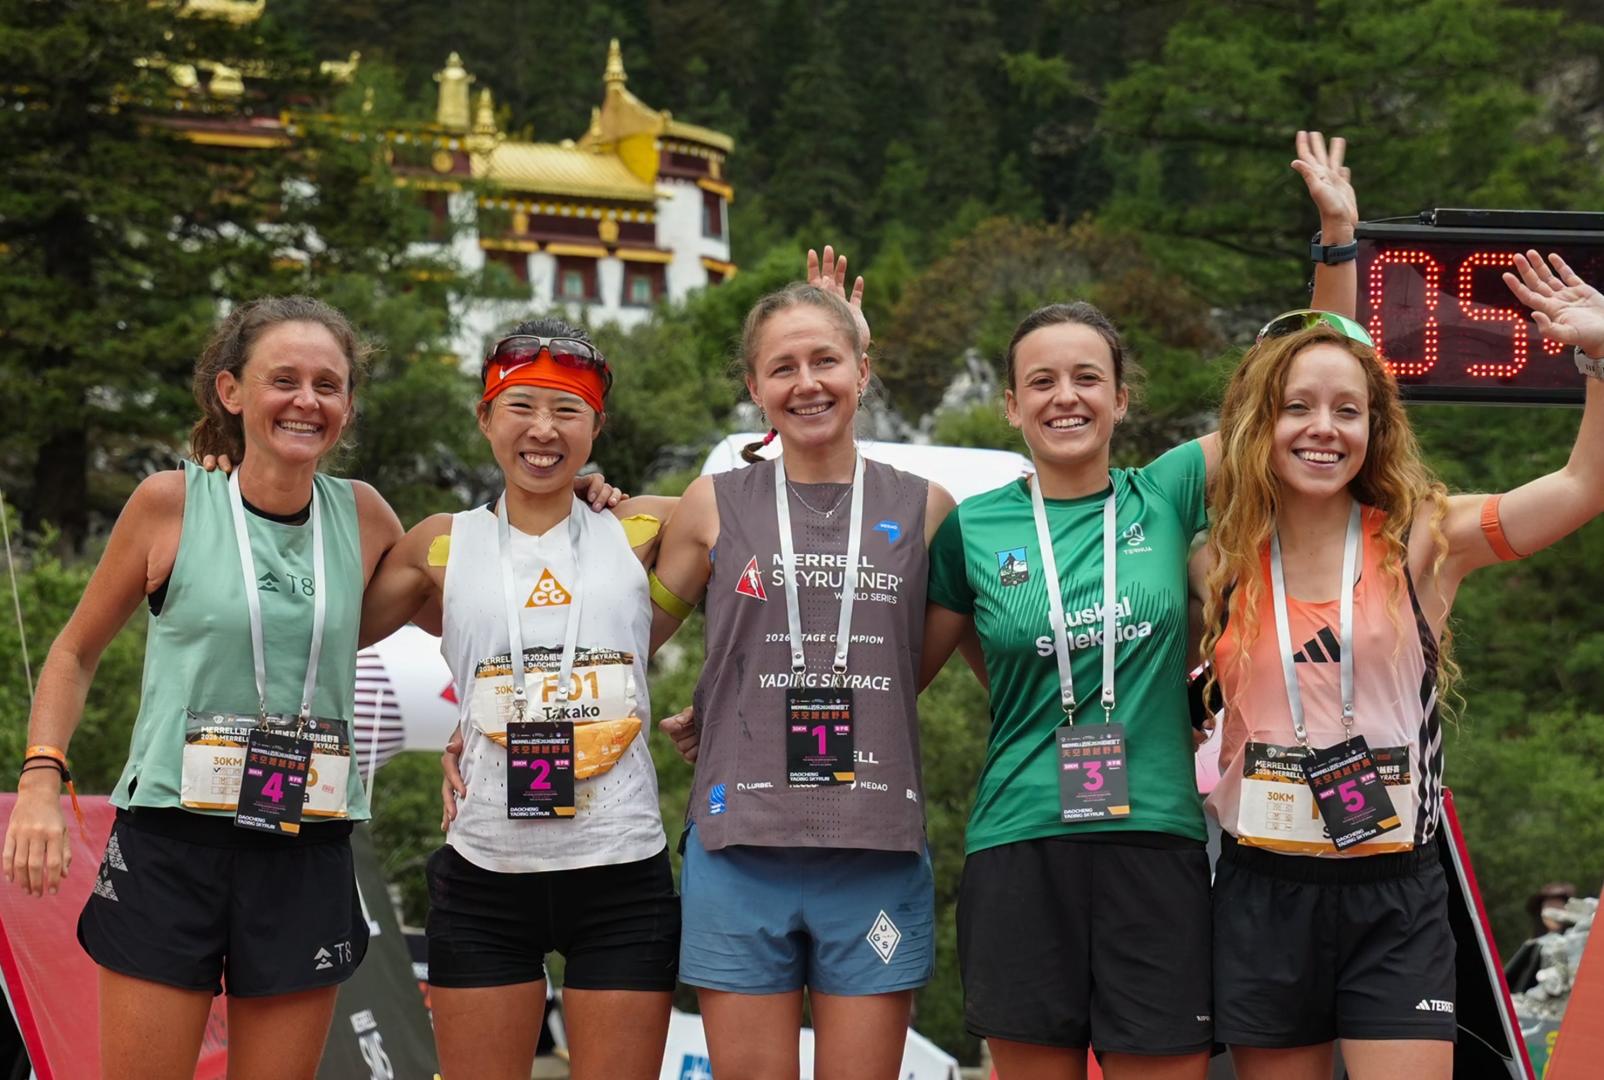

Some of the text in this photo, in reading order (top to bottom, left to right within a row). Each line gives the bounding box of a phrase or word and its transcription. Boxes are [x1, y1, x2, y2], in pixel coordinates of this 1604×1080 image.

[286, 573, 315, 597] T8
[834, 592, 898, 605] WRLD SERIES
[765, 633, 884, 644] 2026 TAGE CMPION
[1035, 620, 1152, 657] Slekioa
[494, 685, 513, 695] 30K
[758, 673, 816, 689] YADING
[812, 725, 826, 755] 1
[213, 756, 243, 766] 30KM
[530, 759, 552, 790] 2
[1082, 761, 1104, 791] 3
[261, 772, 284, 803] 4
[1267, 791, 1294, 803] 30KM
[1338, 779, 1366, 813] 5
[334, 941, 352, 965] T8
